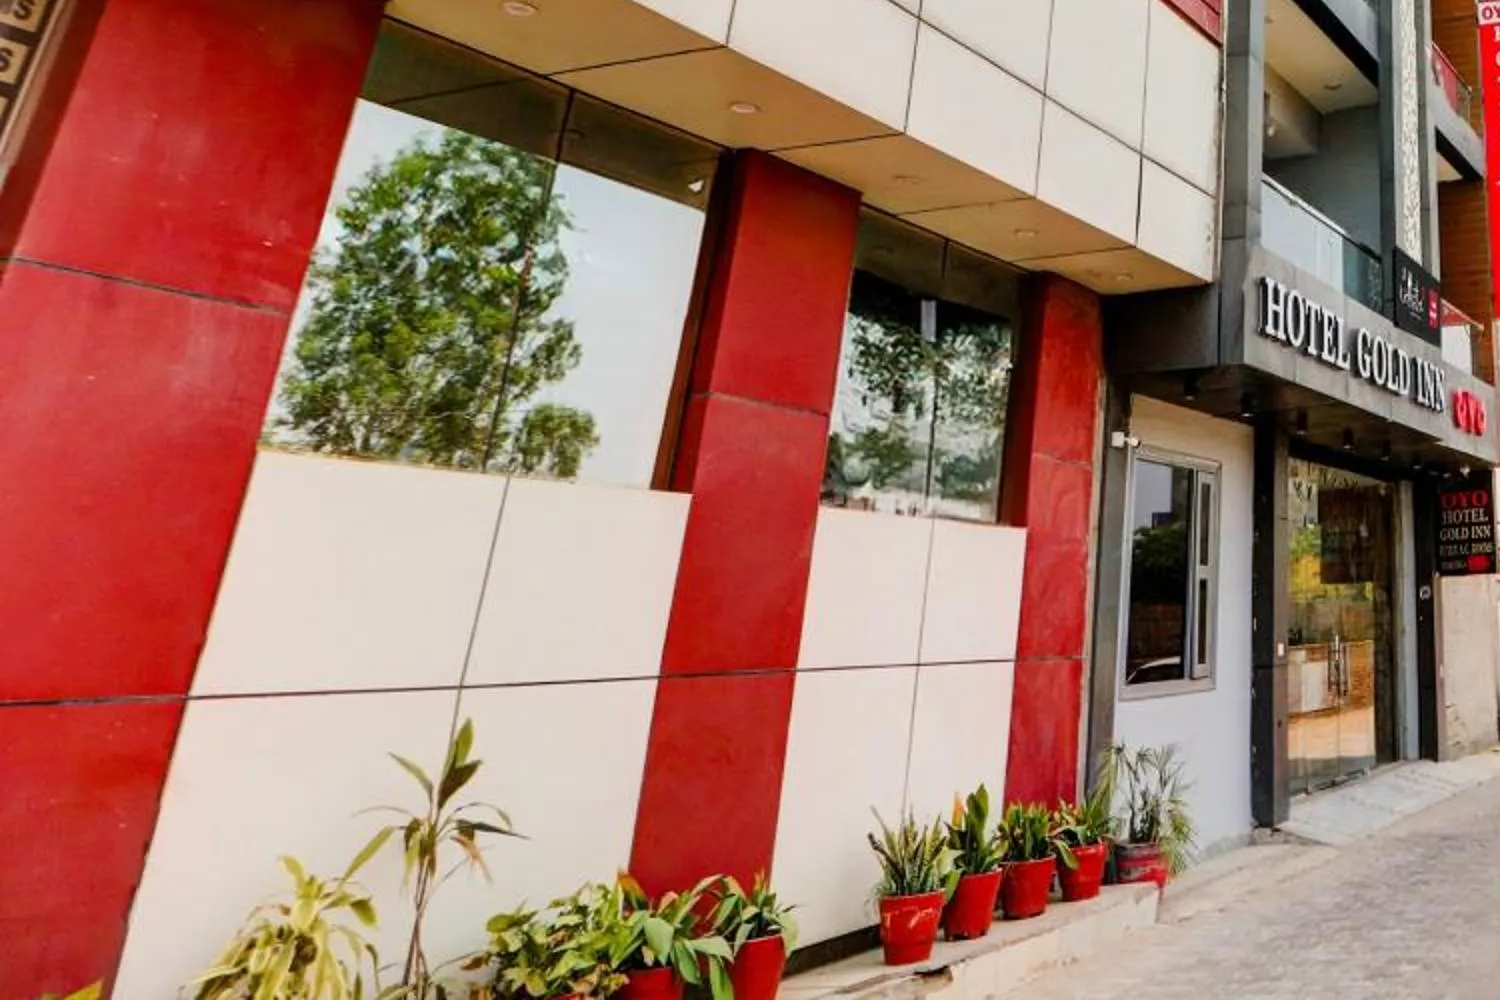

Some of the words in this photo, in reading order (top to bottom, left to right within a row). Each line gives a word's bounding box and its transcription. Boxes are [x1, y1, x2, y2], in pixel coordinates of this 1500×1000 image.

[1260, 275, 1350, 371] HOTEL
[1356, 327, 1411, 396] GOLD
[1414, 356, 1446, 412] INN
[1441, 490, 1488, 508] OYO
[1442, 508, 1488, 525] HOTEL
[1440, 527, 1470, 542] GOLD
[1471, 524, 1491, 539] INN
